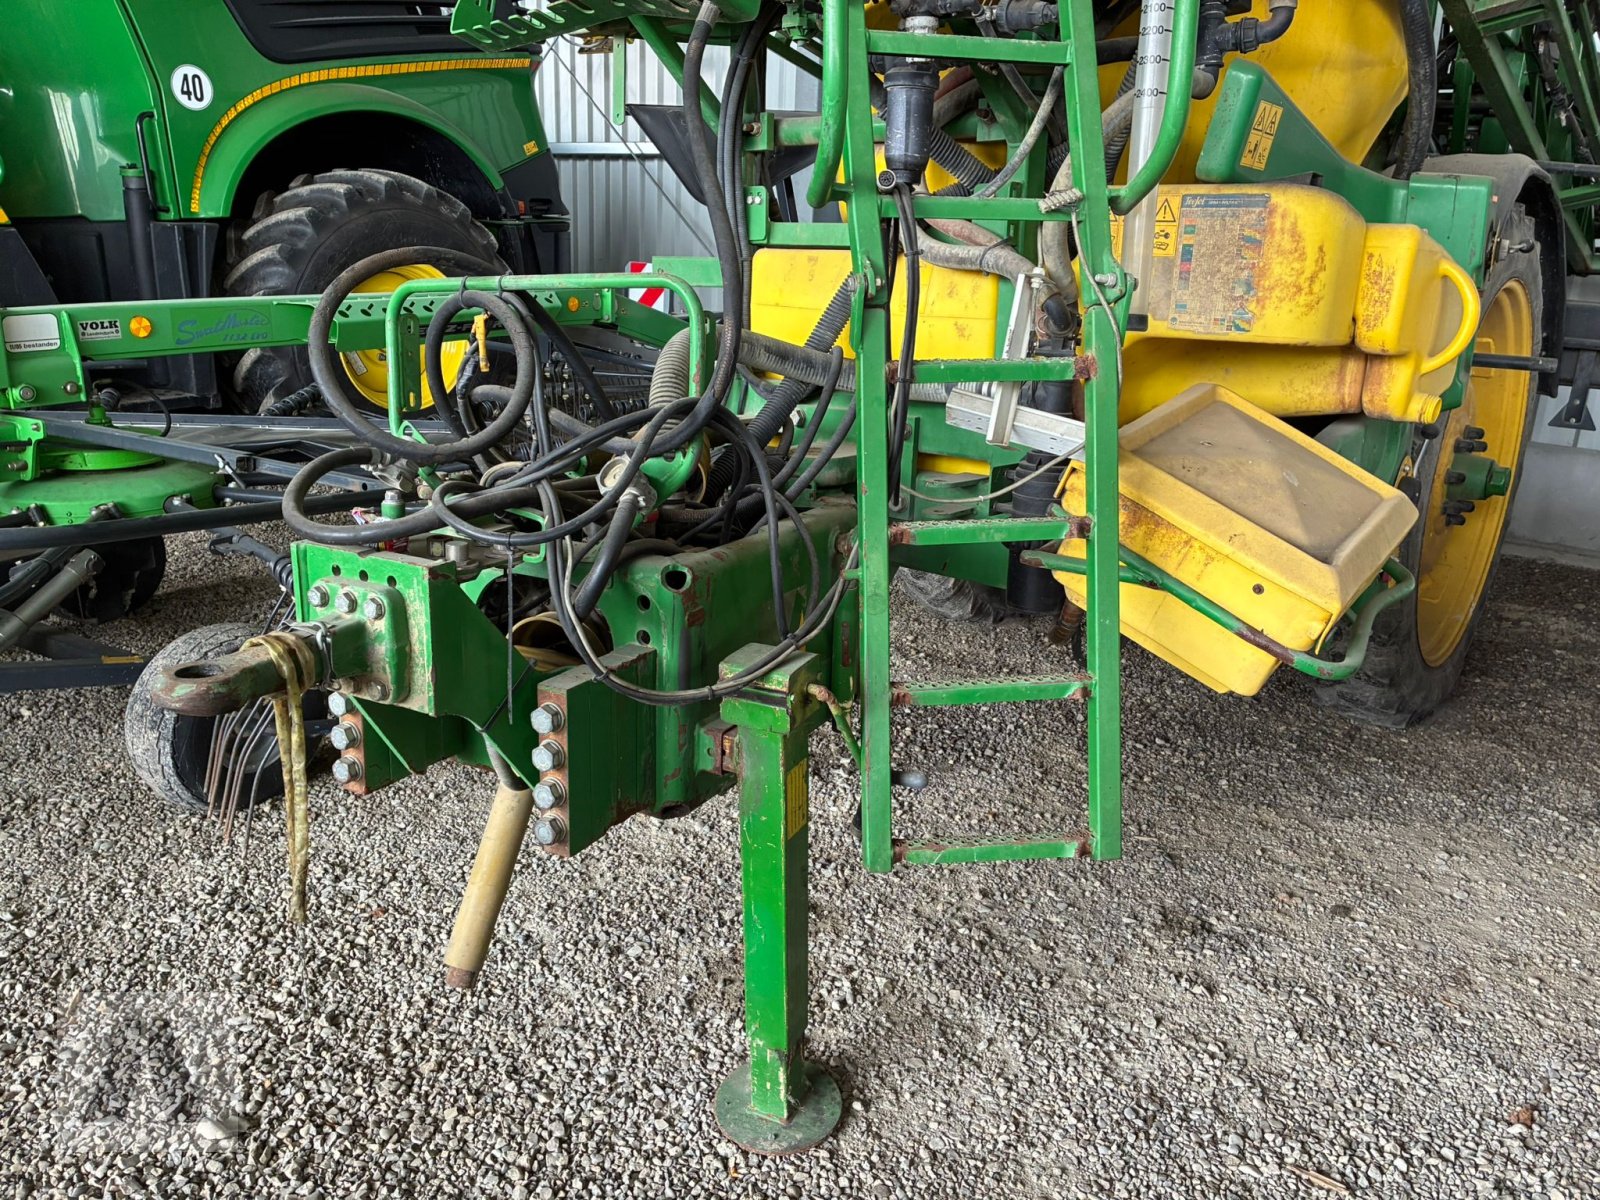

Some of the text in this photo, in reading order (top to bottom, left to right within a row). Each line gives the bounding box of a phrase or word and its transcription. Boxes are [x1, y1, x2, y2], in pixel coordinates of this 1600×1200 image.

[1143, 3, 1166, 14] 2100
[1141, 25, 1164, 36] 2200
[1138, 55, 1162, 65] 2300
[180, 73, 204, 102] 40
[1136, 88, 1159, 98] 2400
[79, 320, 119, 331] VOLK
[23, 341, 58, 349] bestanden
